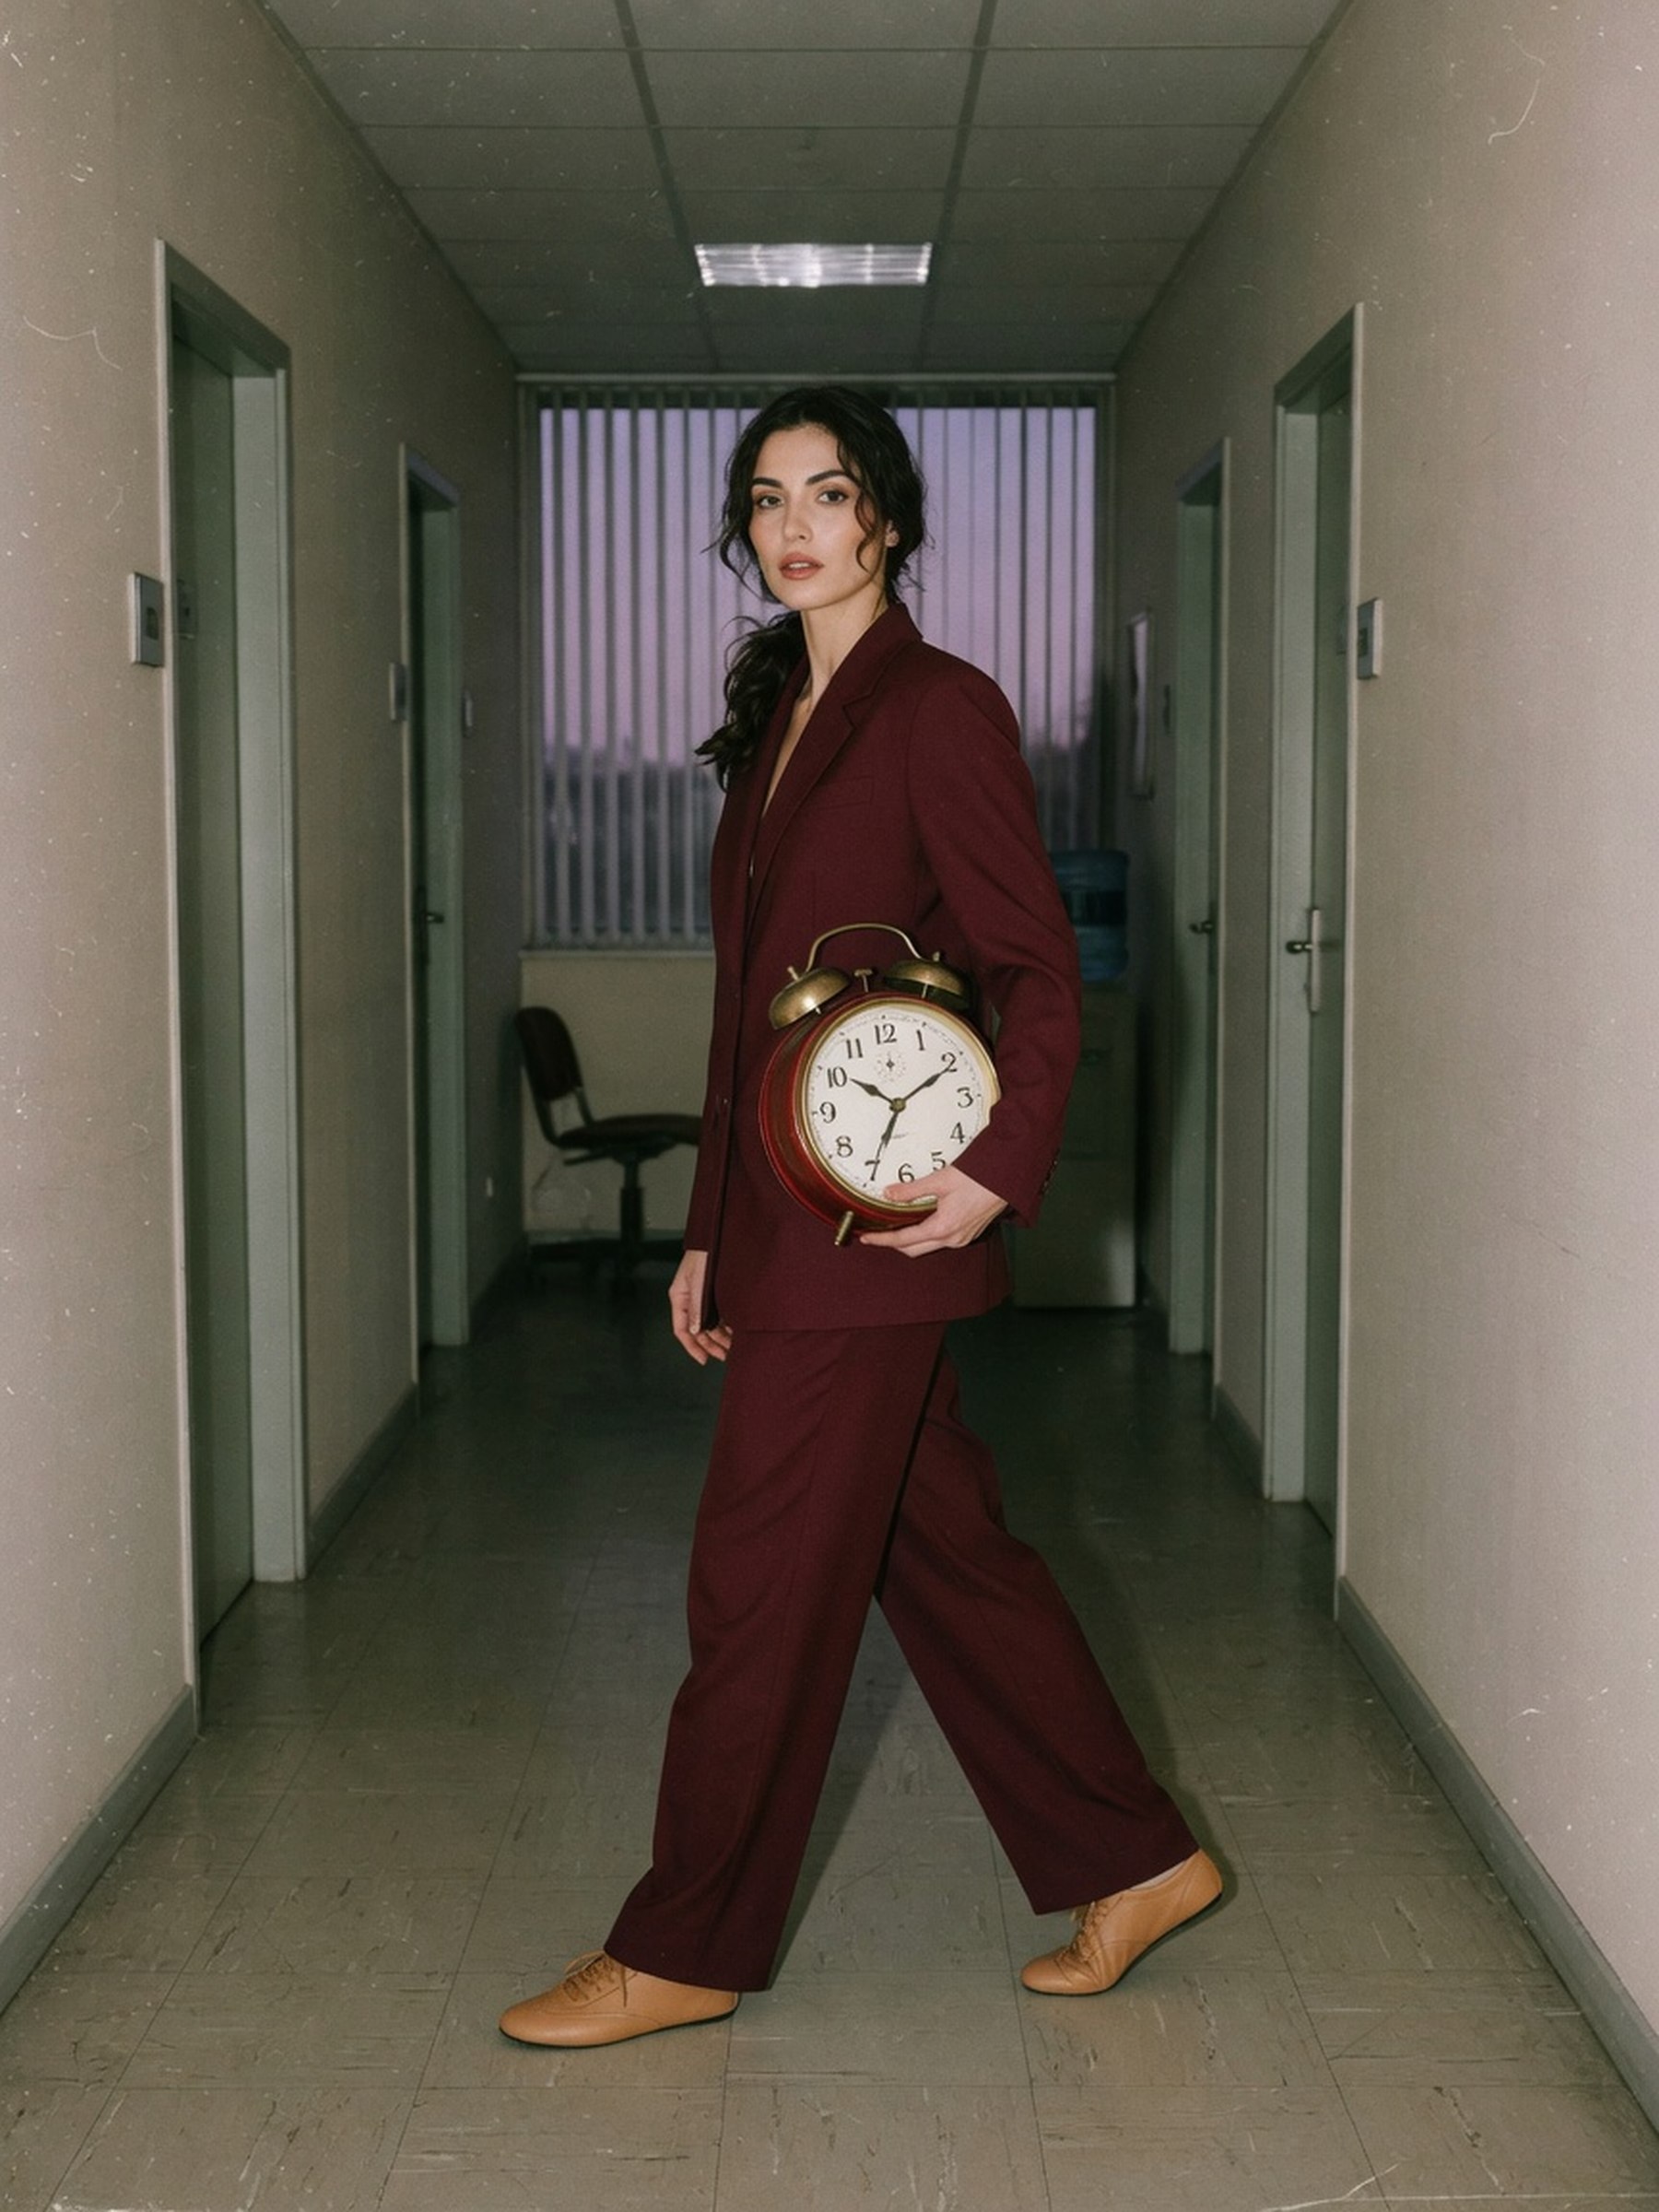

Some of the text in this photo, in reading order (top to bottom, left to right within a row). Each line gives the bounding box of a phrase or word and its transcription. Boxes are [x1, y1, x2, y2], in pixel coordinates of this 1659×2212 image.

[875, 1023, 897, 1044] 12
[916, 1030, 925, 1051] 1
[846, 1038, 864, 1059] 11
[941, 1053, 958, 1073] 2
[827, 1066, 847, 1088] 10
[957, 1087, 973, 1108] 3
[819, 1101, 836, 1124] 9
[950, 1123, 965, 1144] 4
[836, 1135, 853, 1158] 8
[865, 1159, 880, 1182] 7
[931, 1151, 946, 1171] 5
[898, 1163, 914, 1183] 6
